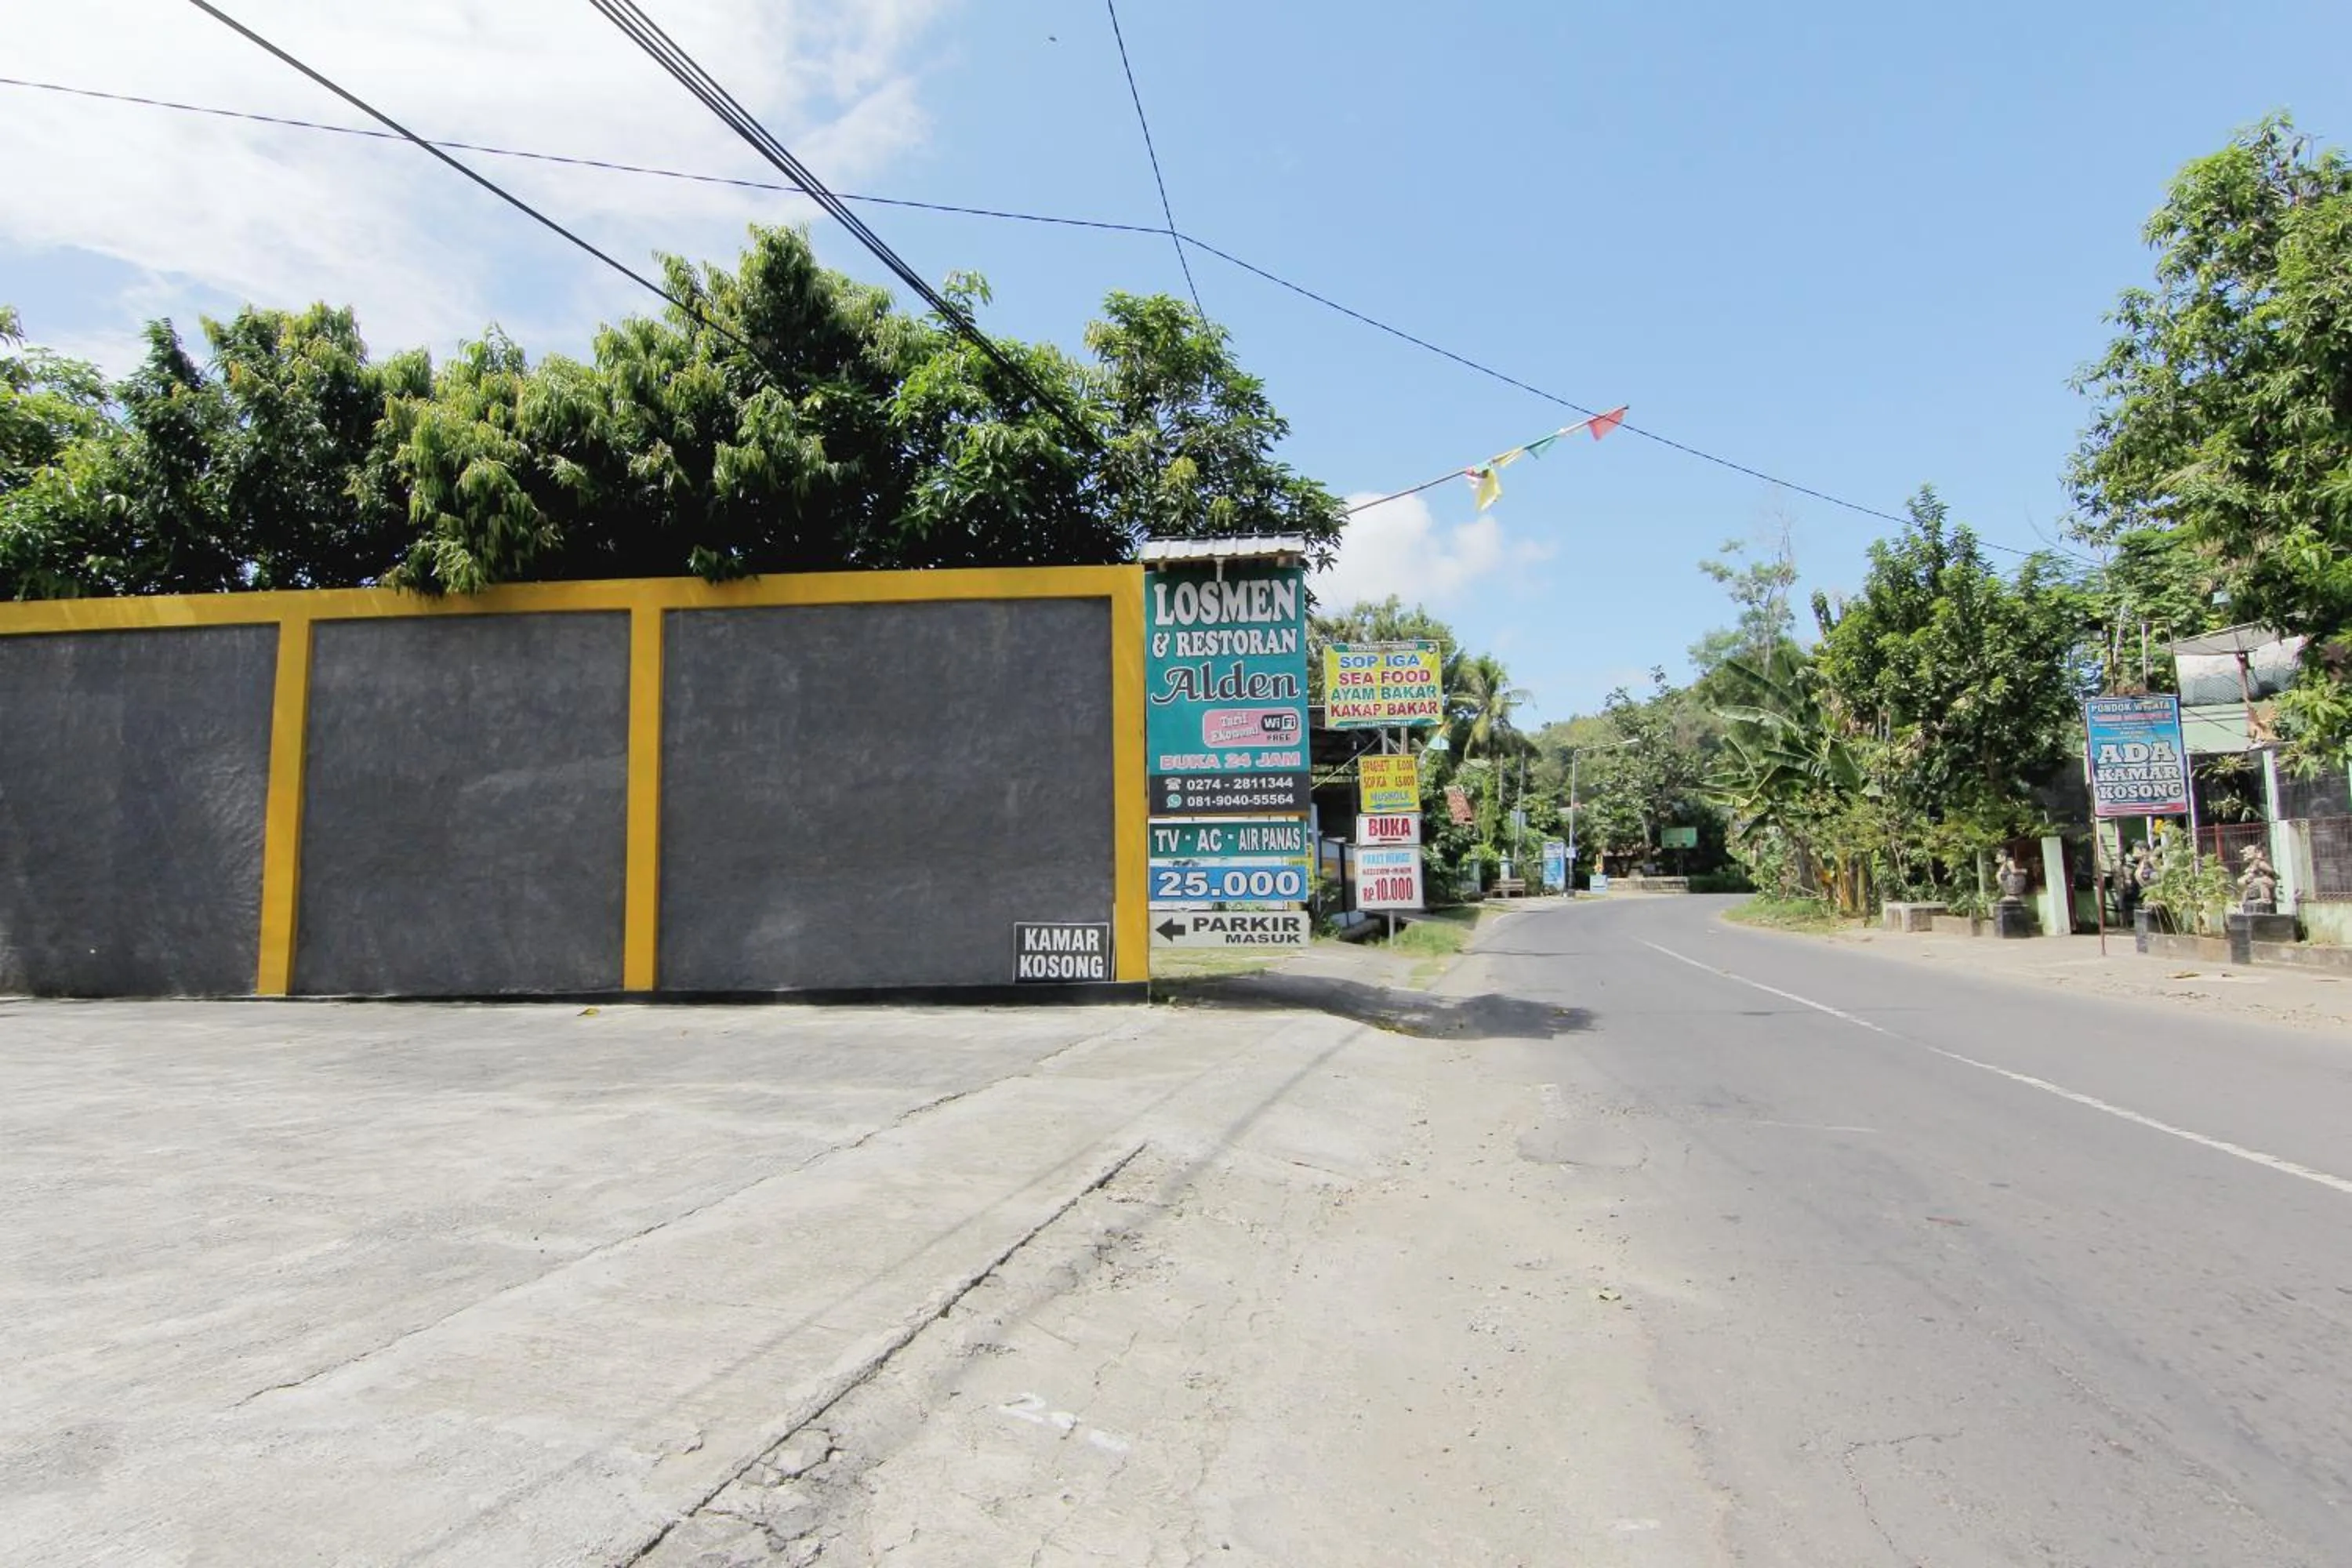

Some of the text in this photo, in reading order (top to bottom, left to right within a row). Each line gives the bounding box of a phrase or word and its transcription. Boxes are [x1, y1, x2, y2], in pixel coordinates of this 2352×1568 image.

[1154, 579, 1297, 626] LOSMEN
[1152, 629, 1298, 658] & RESTORAN
[1340, 655, 1420, 668] SOP IGA
[1151, 660, 1301, 705] Alden
[1339, 670, 1431, 685] SEA FOOD
[1331, 685, 1438, 701] AYAM BAKAR
[1330, 701, 1439, 717] KAKAP BAKAR
[1160, 752, 1301, 770] BUKA 24 JAM
[2098, 741, 2176, 764] ADA
[2097, 765, 2180, 782] KAMAR
[1187, 779, 1221, 790] 0274
[1234, 777, 1294, 789] 2811344
[2099, 783, 2182, 799] KOSONG
[1368, 818, 1411, 836] BUKA
[1155, 827, 1301, 851] TV AC AIR PANAS
[1158, 871, 1301, 896] 25.000
[1375, 877, 1413, 901] 10.000
[1192, 916, 1301, 931] PARKIR
[1025, 927, 1099, 951] KAMAR
[1225, 934, 1301, 944] MASUK
[1019, 954, 1104, 978] KOSONG
